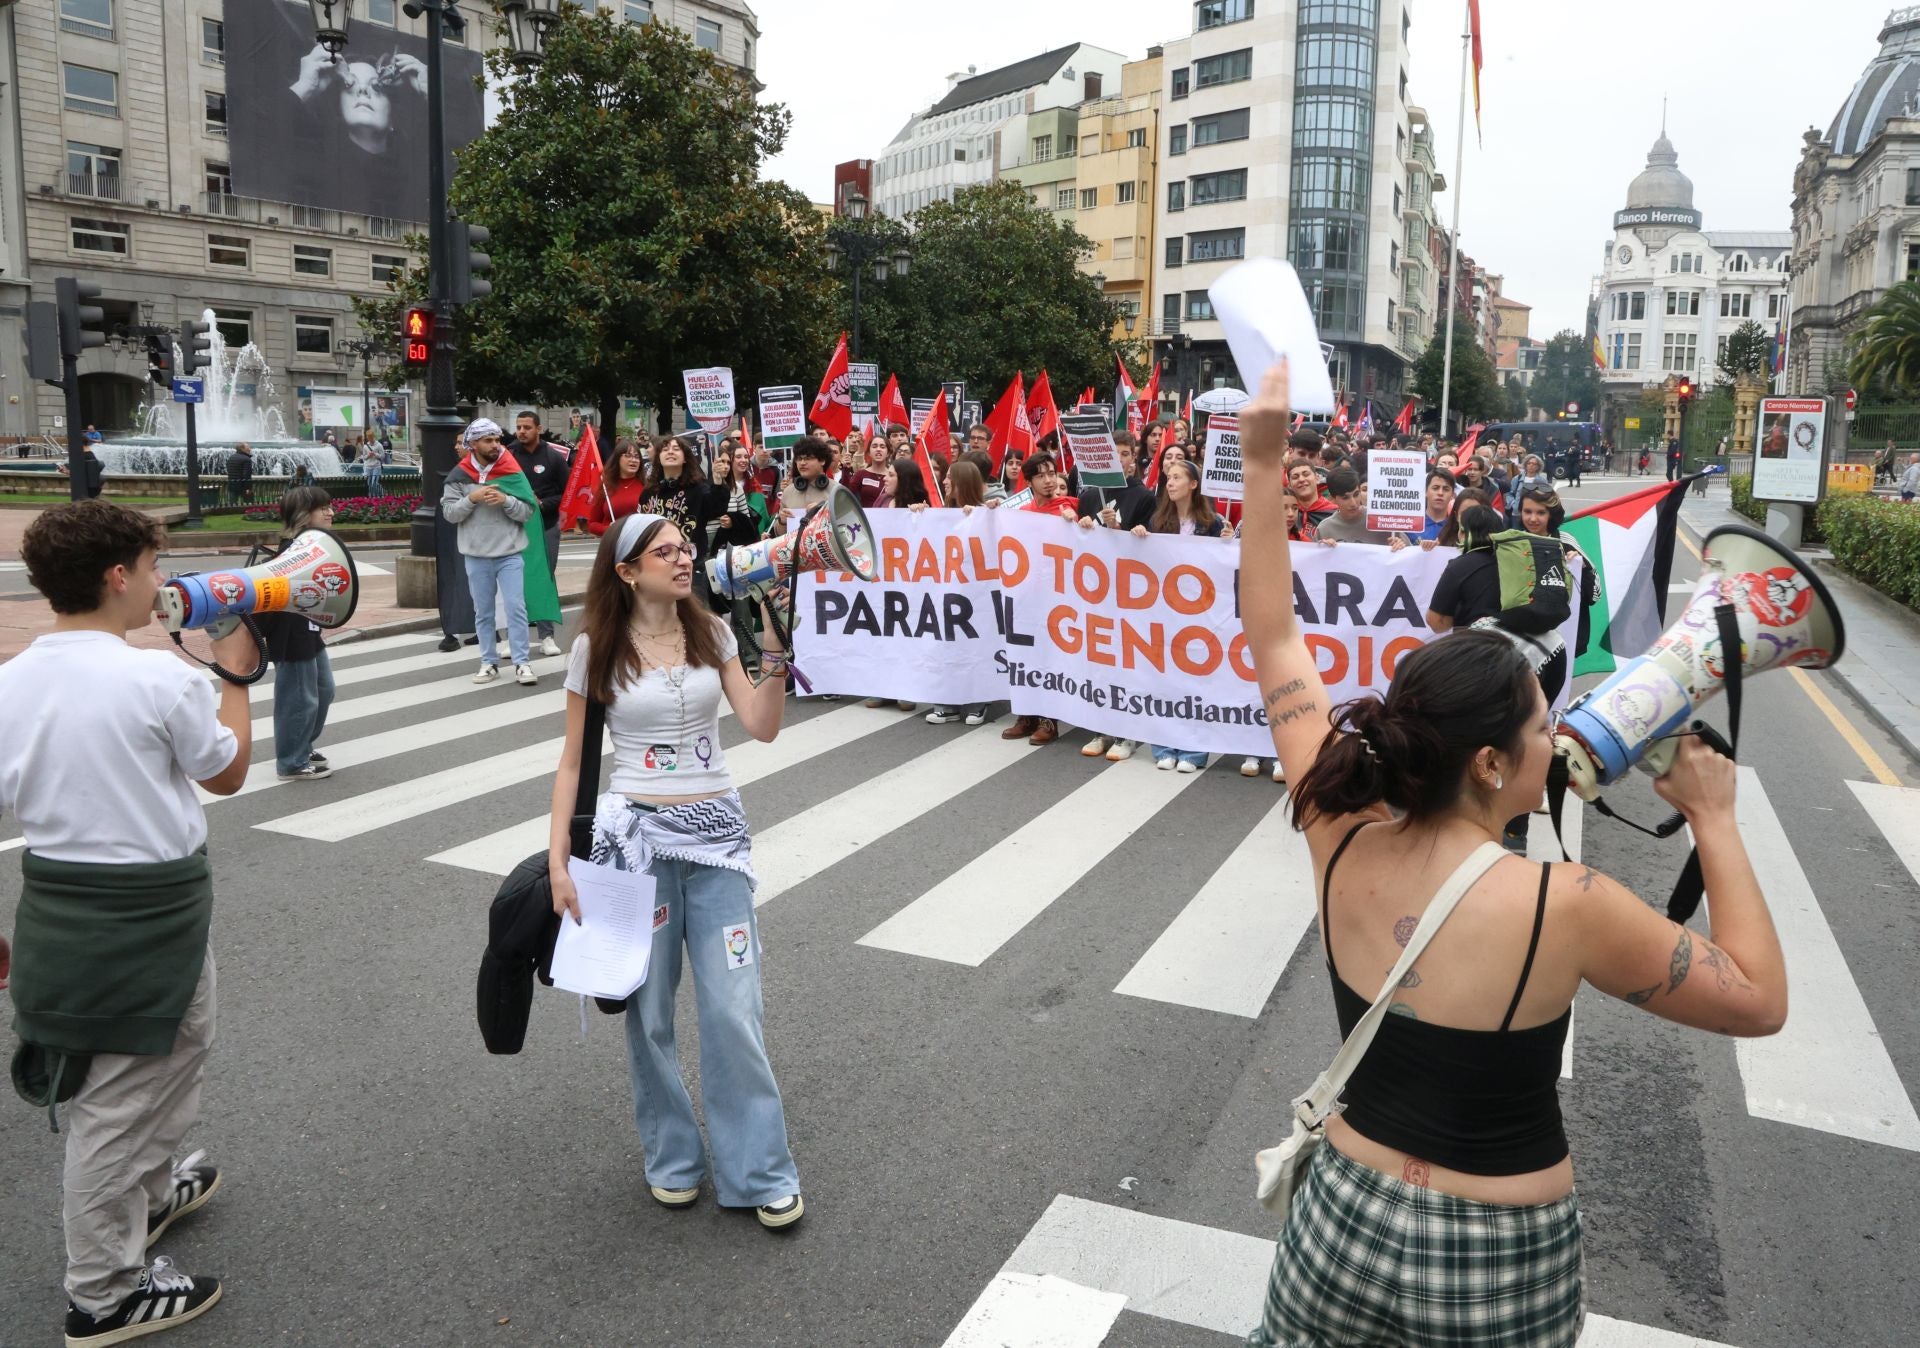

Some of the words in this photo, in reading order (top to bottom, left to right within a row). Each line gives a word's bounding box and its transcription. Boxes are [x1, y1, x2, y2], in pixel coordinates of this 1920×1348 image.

[1618, 213, 1648, 225] Banco
[1651, 211, 1694, 224] Herrero
[409, 344, 426, 360] 60
[687, 374, 720, 383] HUELGA
[688, 380, 724, 390] GENERAL
[690, 393, 731, 402] GENOCIDIO
[691, 401, 699, 409] AL
[700, 400, 728, 408] PUEBLO
[764, 403, 798, 412] SOLIDARIDAD
[691, 406, 730, 415] PALESTINO
[763, 410, 801, 419] INTERNACIONAL
[770, 425, 797, 433] PALESTINA
[1070, 436, 1107, 444] SOLIDARIDAD
[1093, 453, 1114, 461] CAUSA
[1083, 461, 1112, 470] PALESTINA
[1380, 467, 1414, 477] PARARLO
[1387, 478, 1408, 488] TODO
[1373, 489, 1394, 499] PARA
[1394, 490, 1420, 500] PARAR
[1371, 500, 1379, 510] EL
[1380, 501, 1421, 511] GENOCIDIO
[1377, 516, 1405, 524] Sindicato
[1377, 522, 1414, 530] Estudiantes
[1042, 543, 1216, 615] TODO
[814, 590, 979, 641] PARAR
[1047, 604, 1426, 687] GENOCDIO
[1079, 679, 1106, 708] de
[1109, 684, 1270, 727] Estudiante
